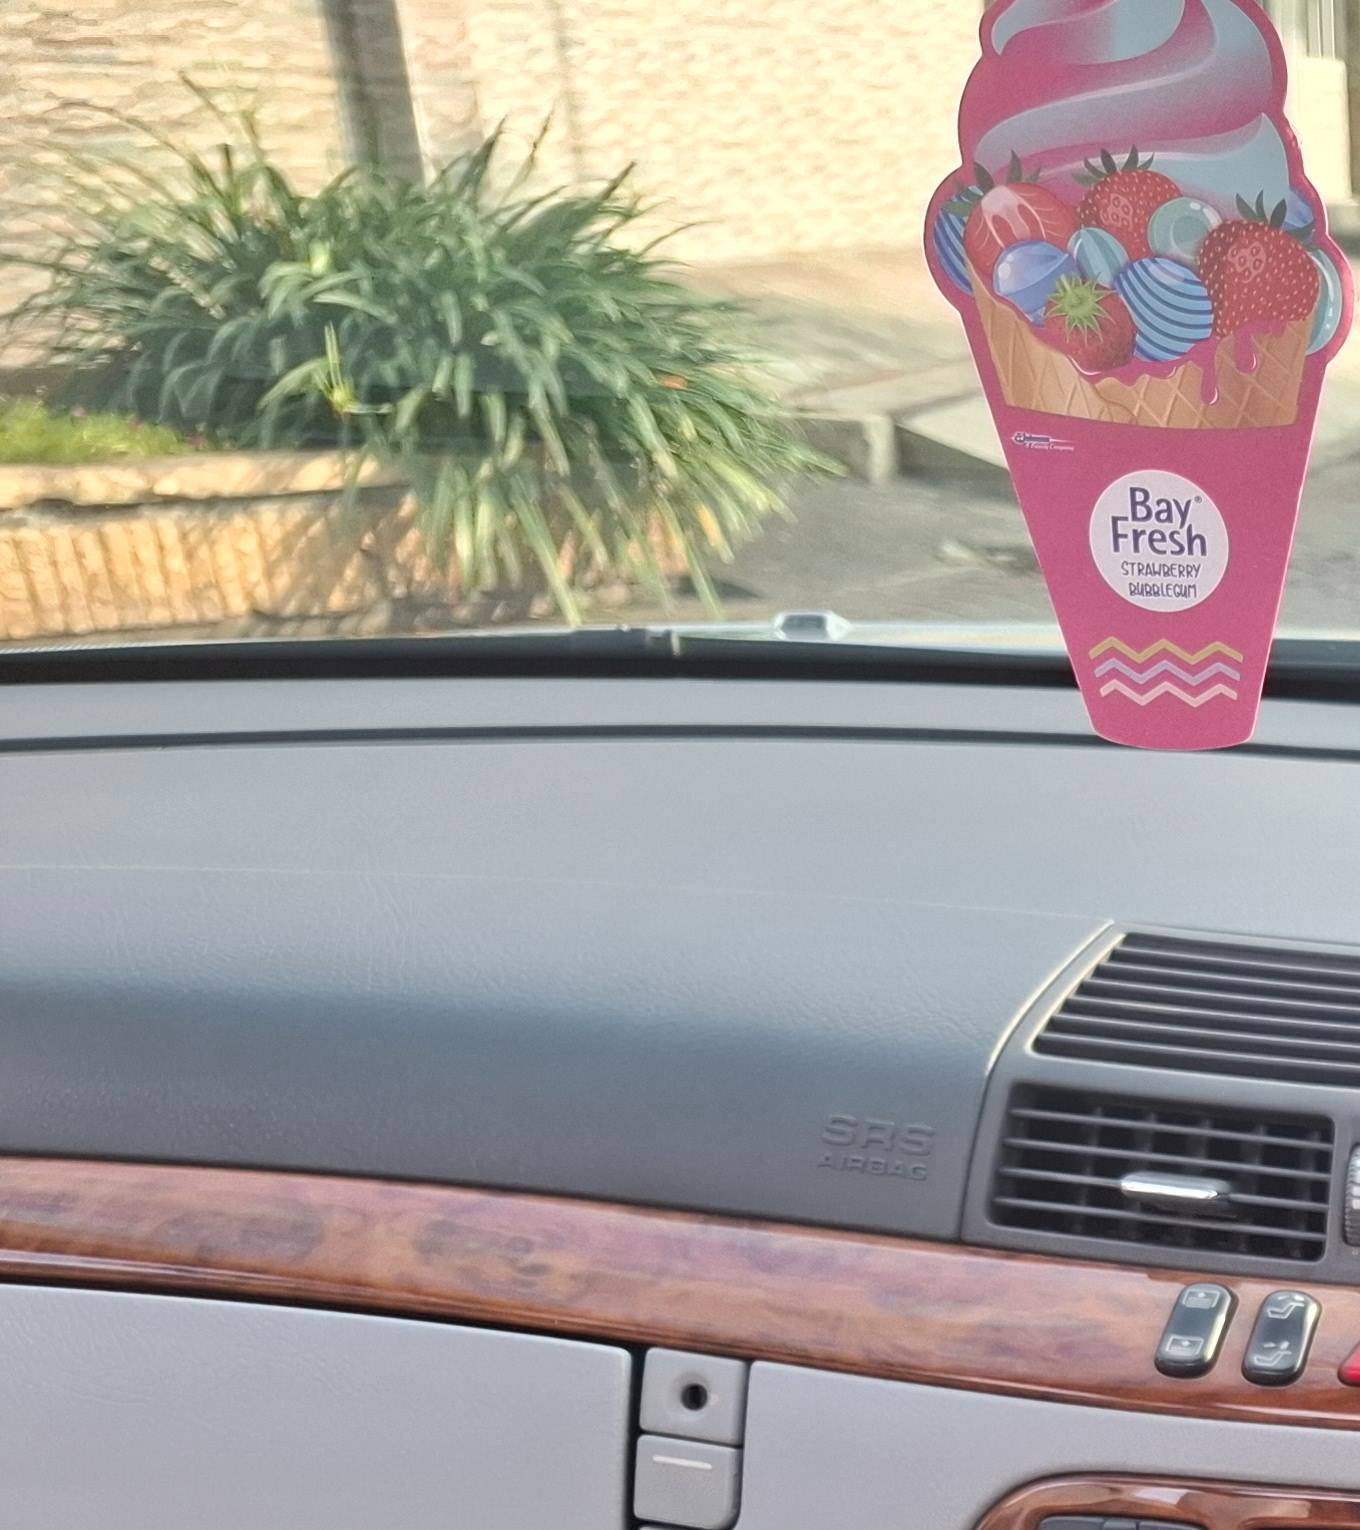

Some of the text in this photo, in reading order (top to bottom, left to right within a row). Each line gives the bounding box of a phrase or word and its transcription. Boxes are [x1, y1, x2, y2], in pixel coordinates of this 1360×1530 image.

[1129, 486, 1192, 530] Bay
[1110, 515, 1208, 557] Fresh
[1121, 560, 1201, 579] STRAWBERRY
[1127, 581, 1198, 599] BUBBLEGUM
